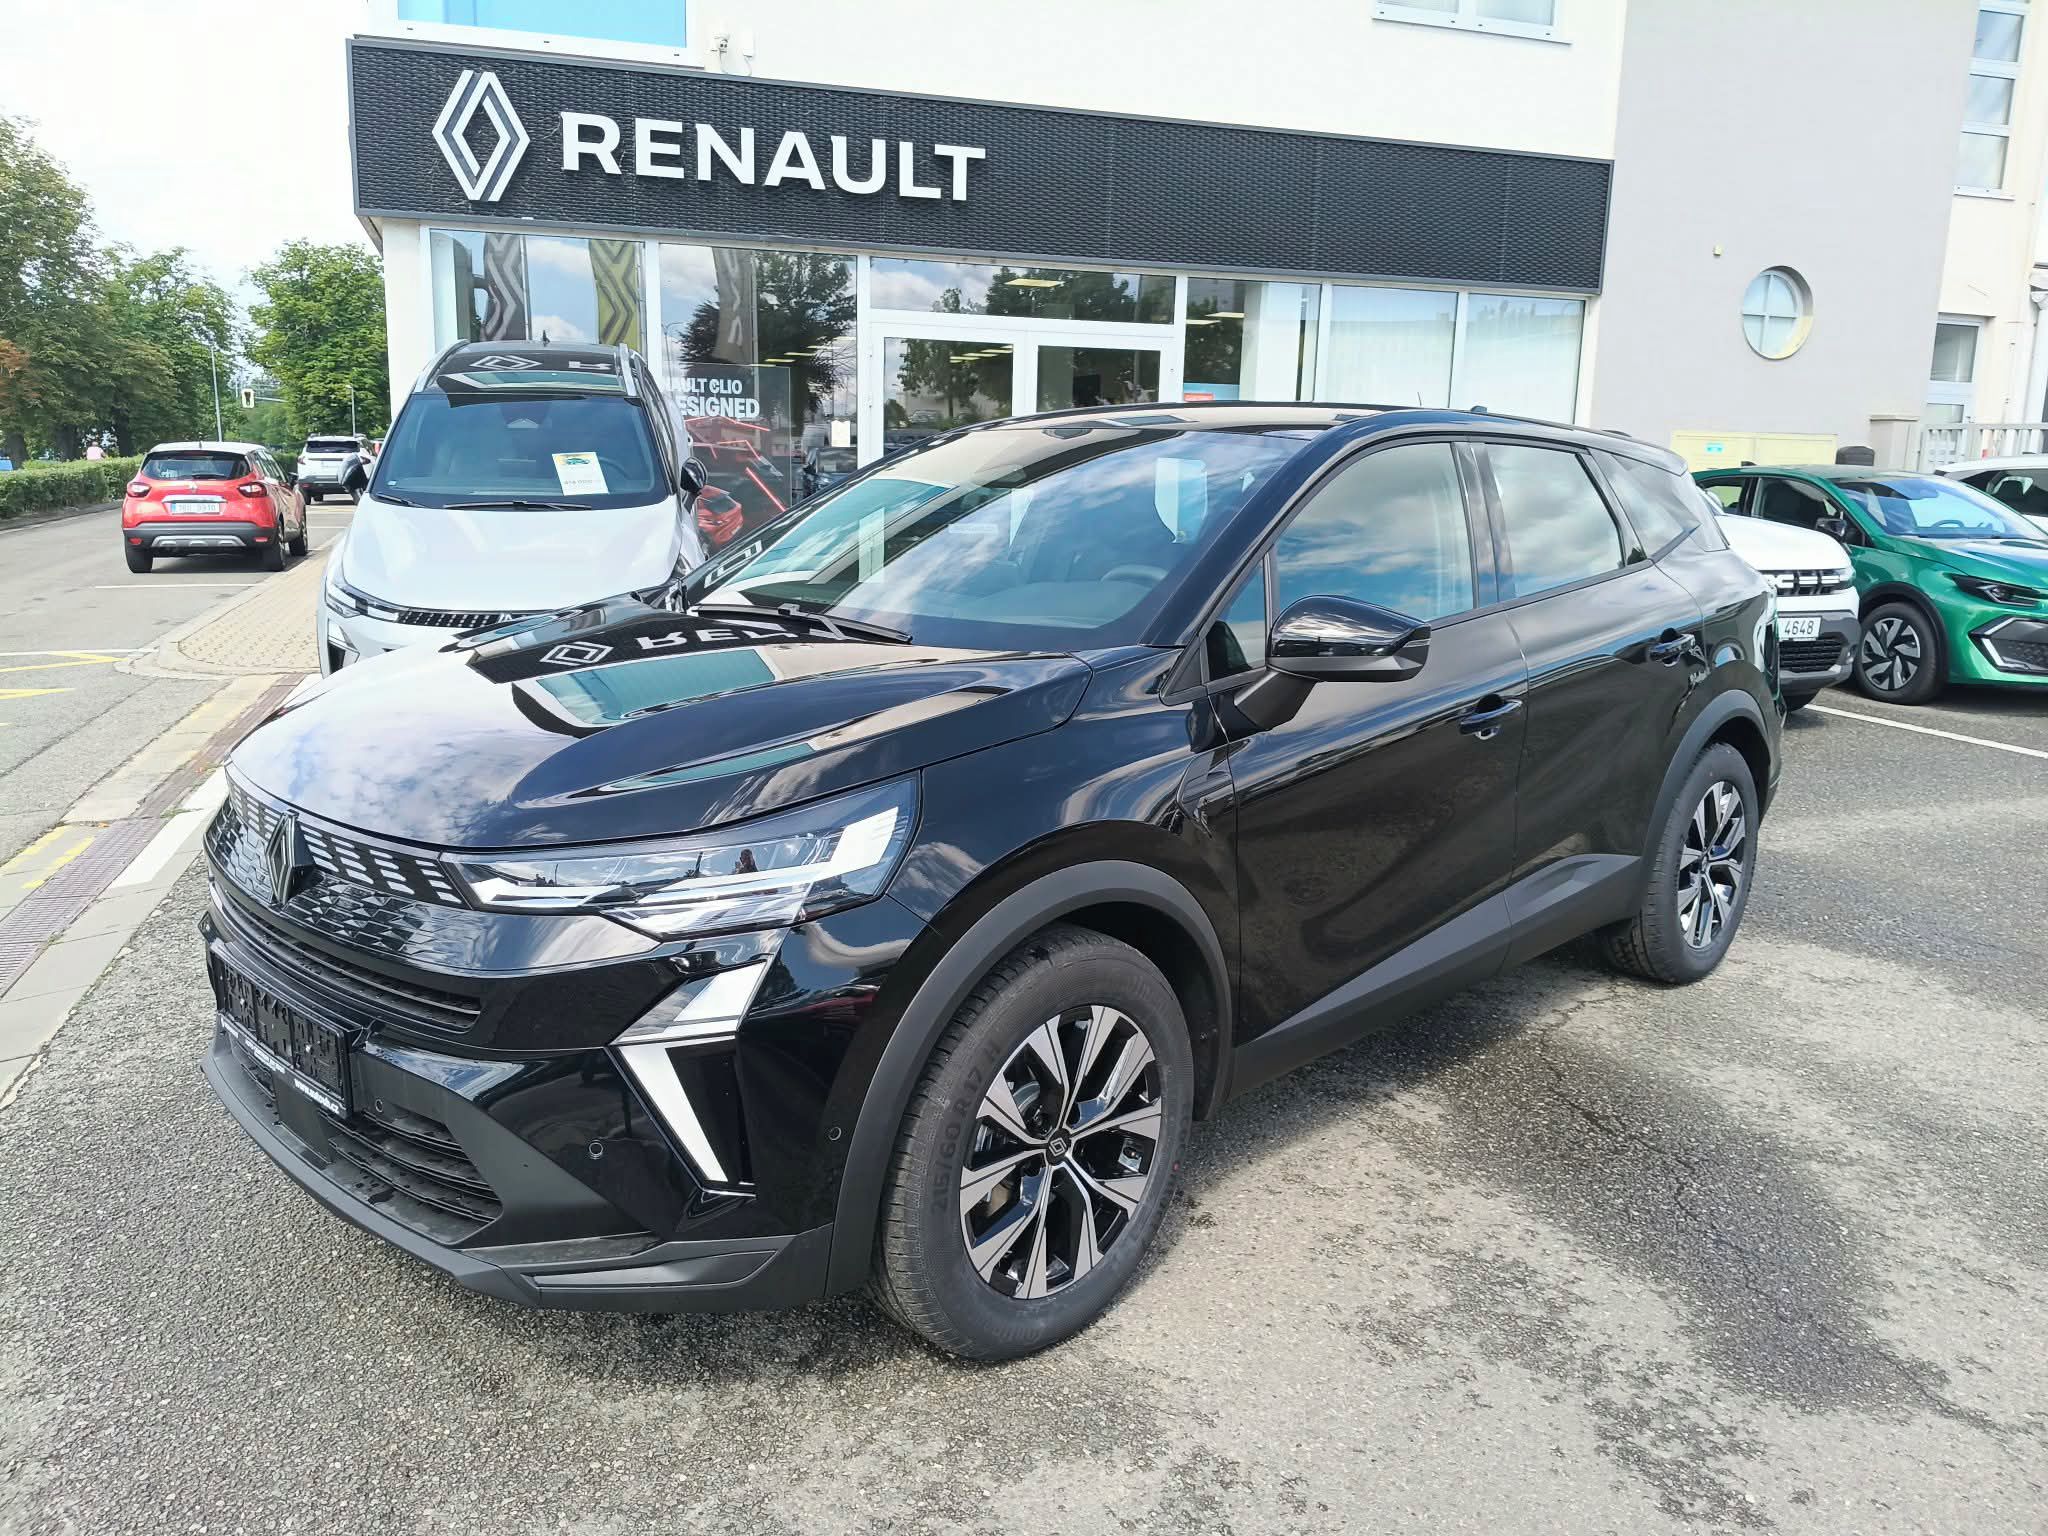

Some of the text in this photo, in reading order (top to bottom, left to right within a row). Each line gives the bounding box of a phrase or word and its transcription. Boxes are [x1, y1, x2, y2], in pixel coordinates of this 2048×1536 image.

[560, 111, 987, 202] RENAULT
[709, 378, 743, 395] CLIO
[1784, 619, 1815, 636] 4648
